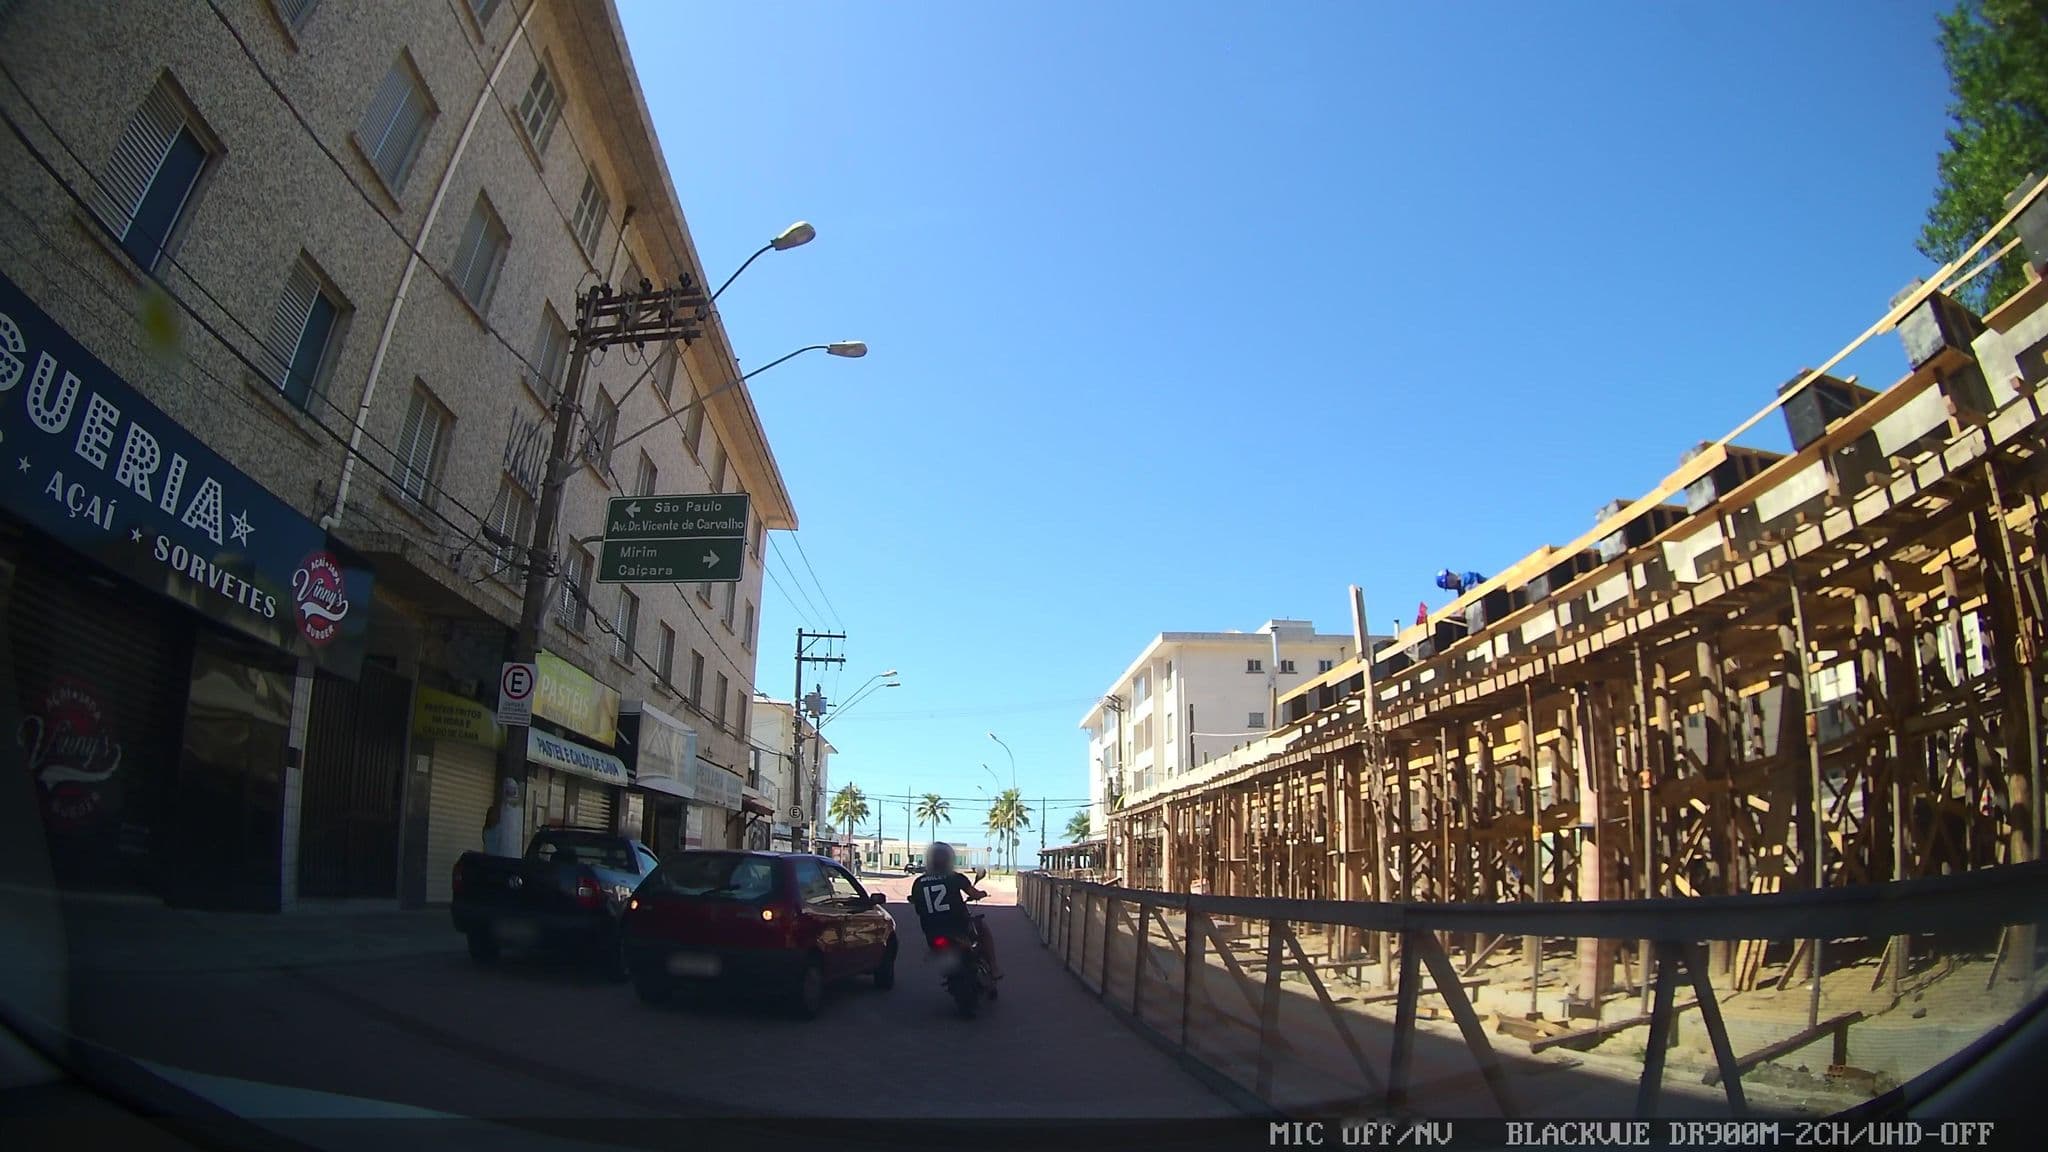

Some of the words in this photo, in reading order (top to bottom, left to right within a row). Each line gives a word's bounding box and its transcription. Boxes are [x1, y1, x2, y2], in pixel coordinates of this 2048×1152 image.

[654, 502, 679, 513] São
[686, 501, 722, 512] Paulo
[682, 520, 694, 530] de
[697, 517, 744, 530] Carvalho
[45, 470, 117, 530] AÇAÍ
[154, 535, 276, 618] SORVETES
[620, 546, 657, 558] Mirim
[618, 564, 673, 577] Caiçara
[292, 568, 344, 611] Vinny's
[511, 672, 524, 693] E
[923, 884, 950, 914] 12
